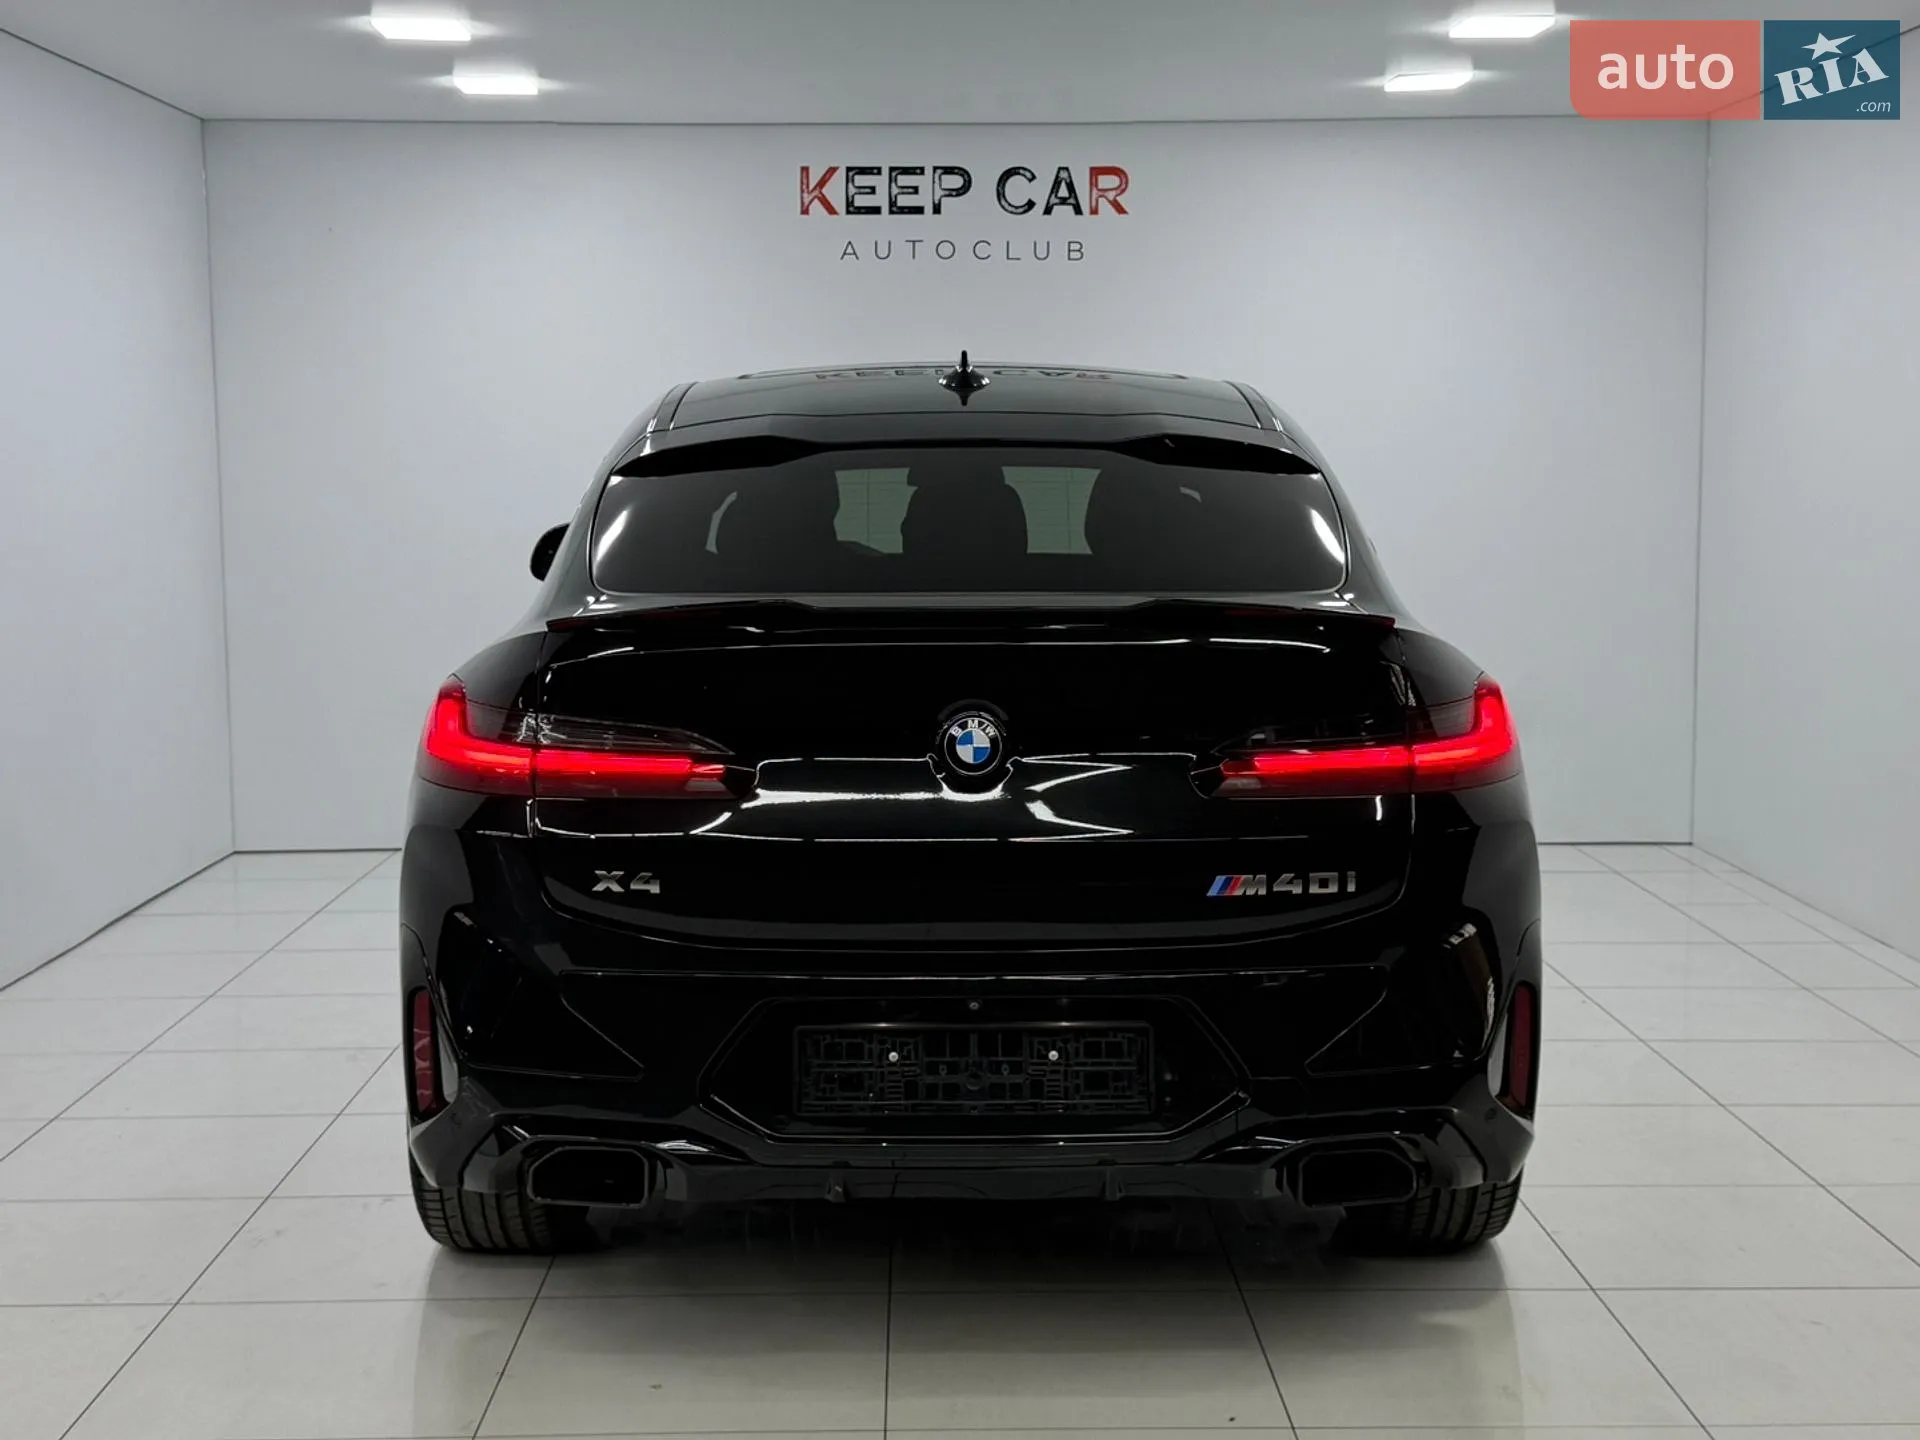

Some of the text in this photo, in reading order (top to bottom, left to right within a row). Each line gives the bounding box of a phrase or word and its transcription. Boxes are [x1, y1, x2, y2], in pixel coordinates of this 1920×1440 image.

[799, 165, 1130, 216] KEEP CAR
[840, 239, 1085, 261] AUTOCLUB
[949, 719, 997, 738] BMW
[591, 870, 661, 894] X4
